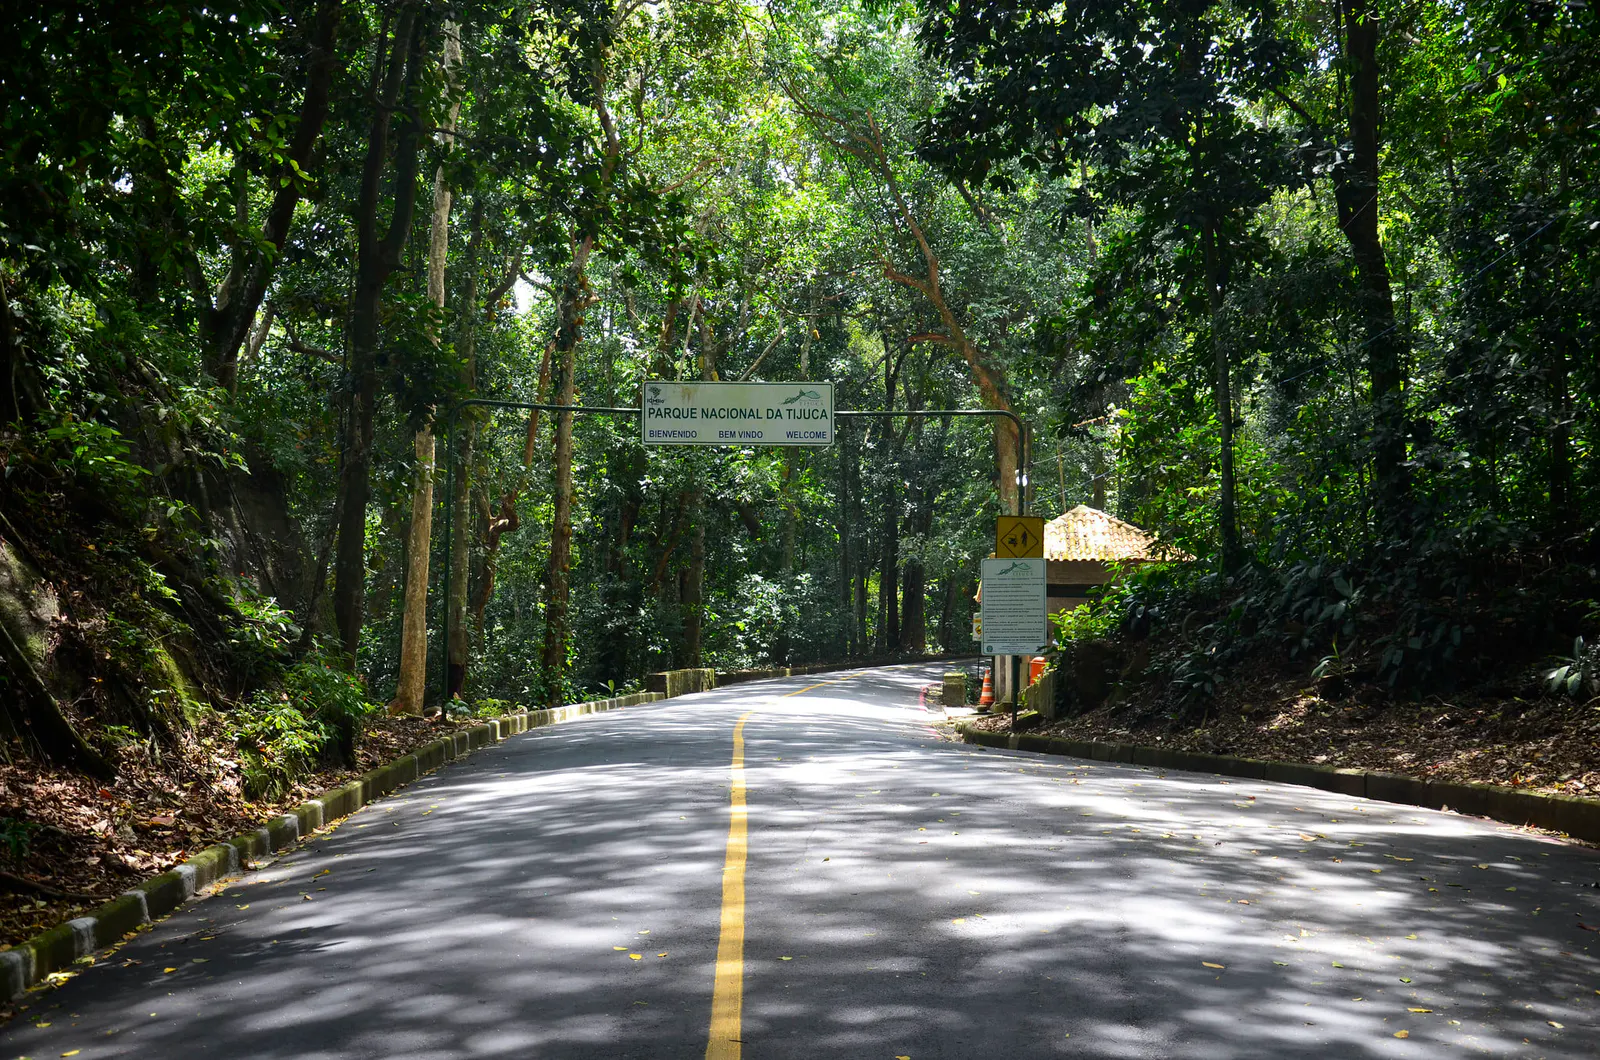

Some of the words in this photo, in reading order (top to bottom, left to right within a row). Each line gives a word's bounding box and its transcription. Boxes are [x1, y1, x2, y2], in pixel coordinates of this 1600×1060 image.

[648, 407, 697, 419] PARQUE
[701, 408, 763, 419] NACIONAL
[766, 408, 783, 419] DA
[786, 408, 828, 419] TIJUCA
[649, 430, 697, 438] BIENVENIDO
[719, 430, 737, 439] BEM
[739, 430, 763, 439] VINDO
[786, 431, 827, 439] WELCOME
